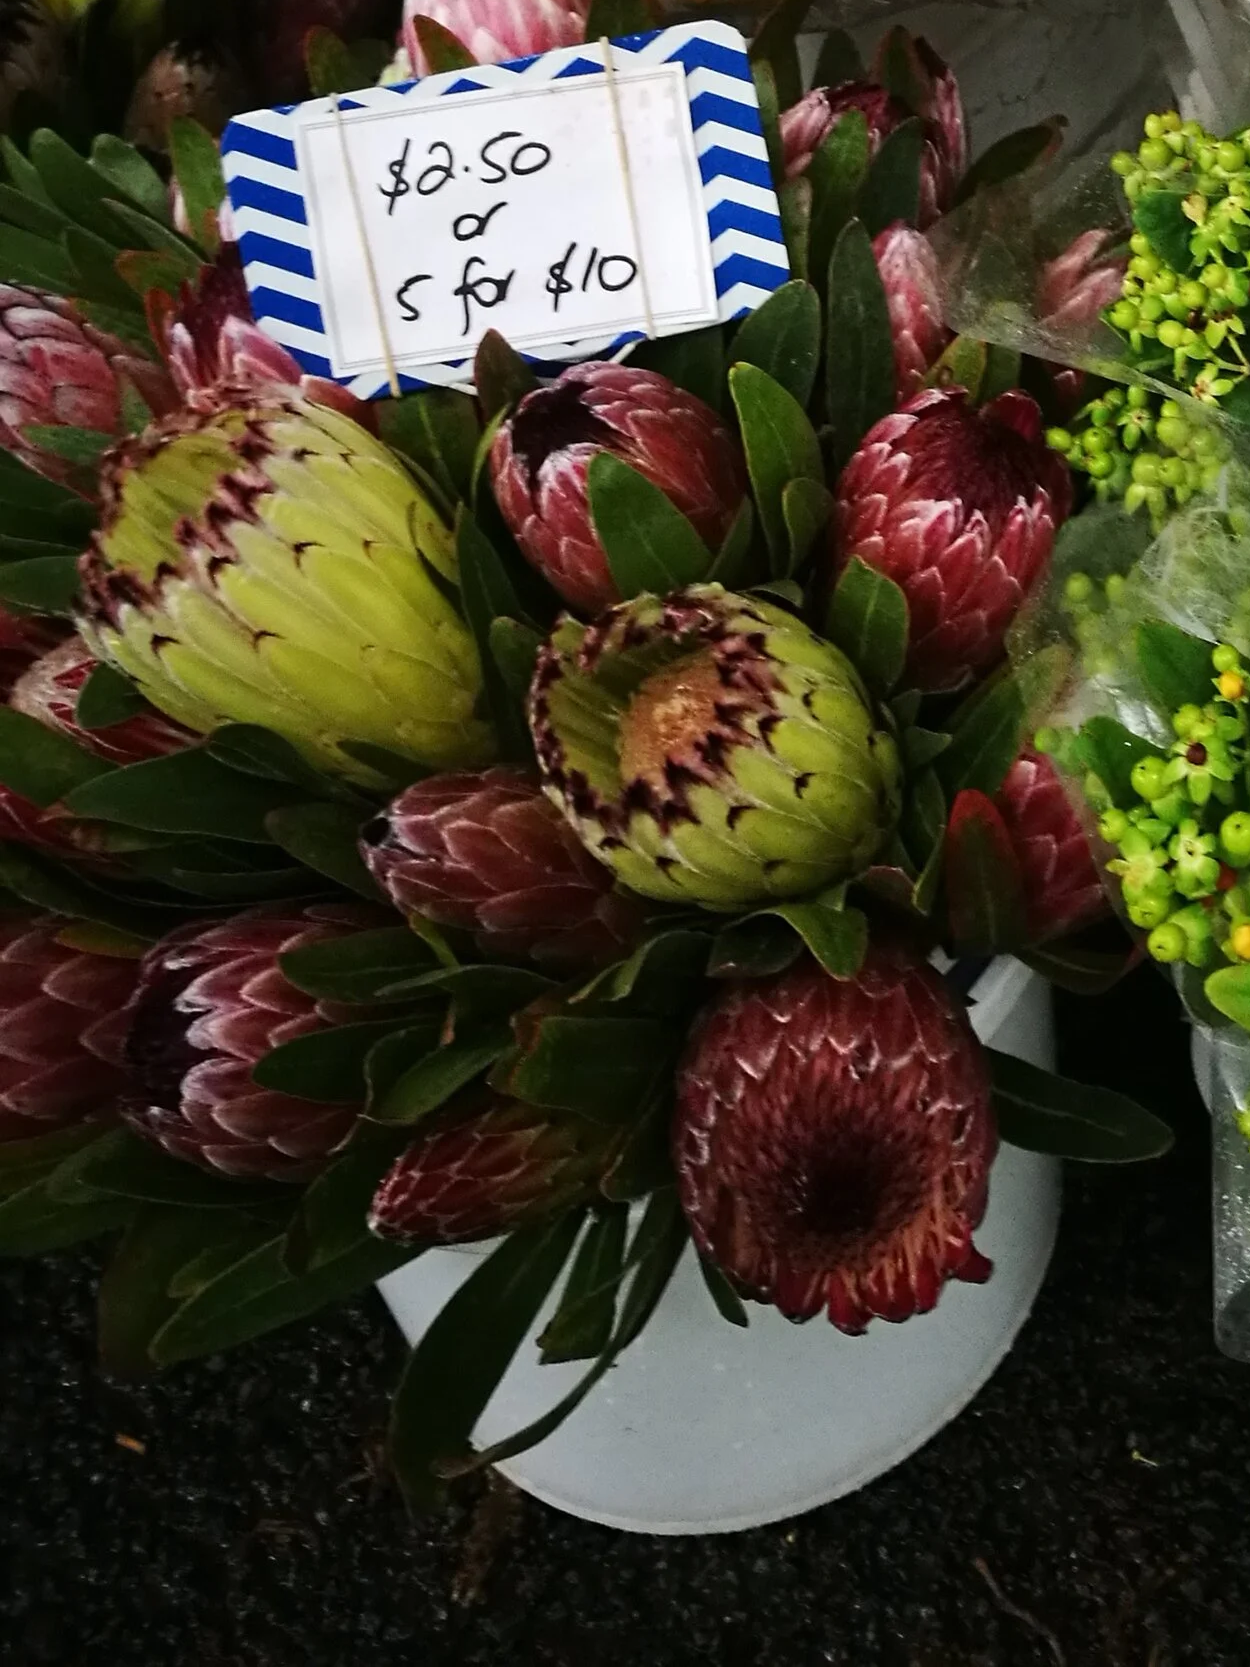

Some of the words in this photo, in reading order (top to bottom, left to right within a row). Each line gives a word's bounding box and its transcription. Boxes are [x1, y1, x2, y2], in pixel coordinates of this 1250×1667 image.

[378, 131, 551, 215] $2.50
[452, 201, 509, 241] or
[396, 273, 434, 321] 5
[454, 256, 515, 335] for
[545, 241, 638, 312] $10
